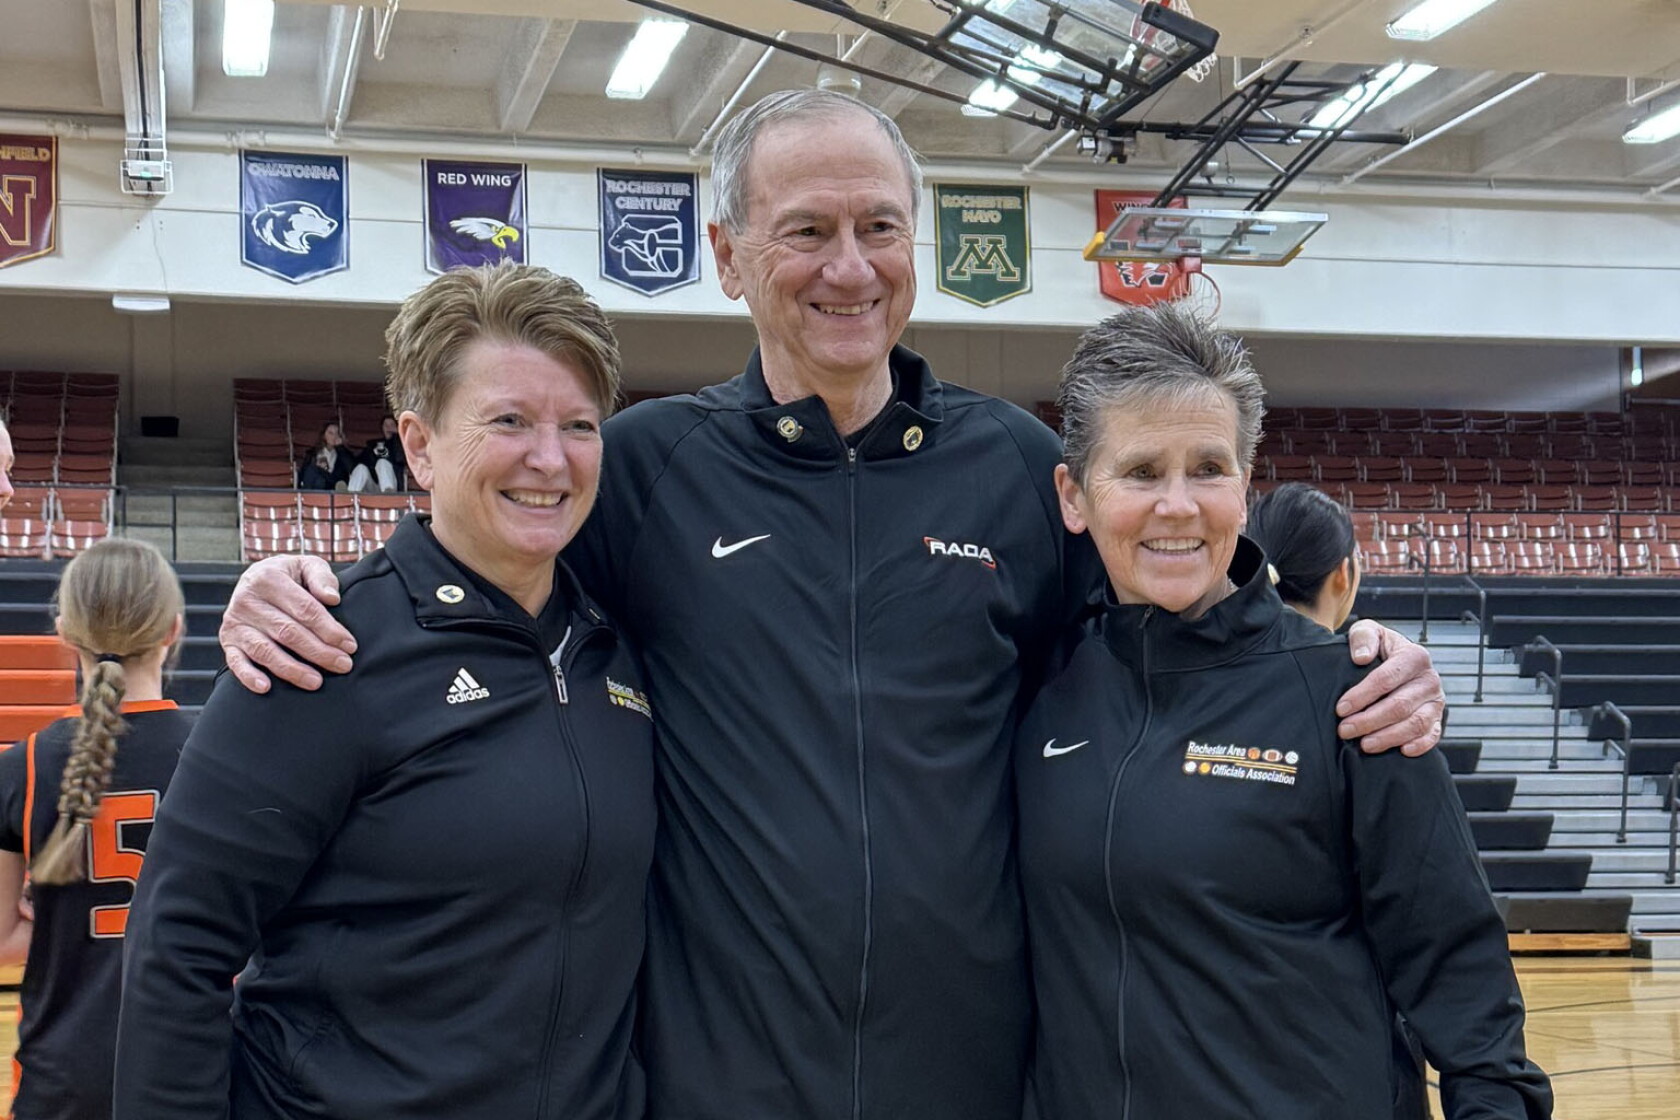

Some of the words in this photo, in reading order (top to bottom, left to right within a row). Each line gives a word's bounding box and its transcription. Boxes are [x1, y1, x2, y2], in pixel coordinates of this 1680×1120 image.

[247, 162, 340, 181] OWATONNA
[437, 172, 467, 185] RED
[470, 174, 512, 187] WING
[606, 180, 691, 196] ROCHESTER
[615, 196, 683, 211] CENTURY
[941, 194, 1022, 209] ROCHESTER
[962, 209, 1002, 223] MAYO
[946, 234, 1021, 281] M
[446, 687, 490, 705] adidas
[1187, 741, 1226, 756] Rochester
[1227, 744, 1246, 757] Area
[1211, 764, 1246, 779] Officials
[1246, 768, 1296, 785] Association
